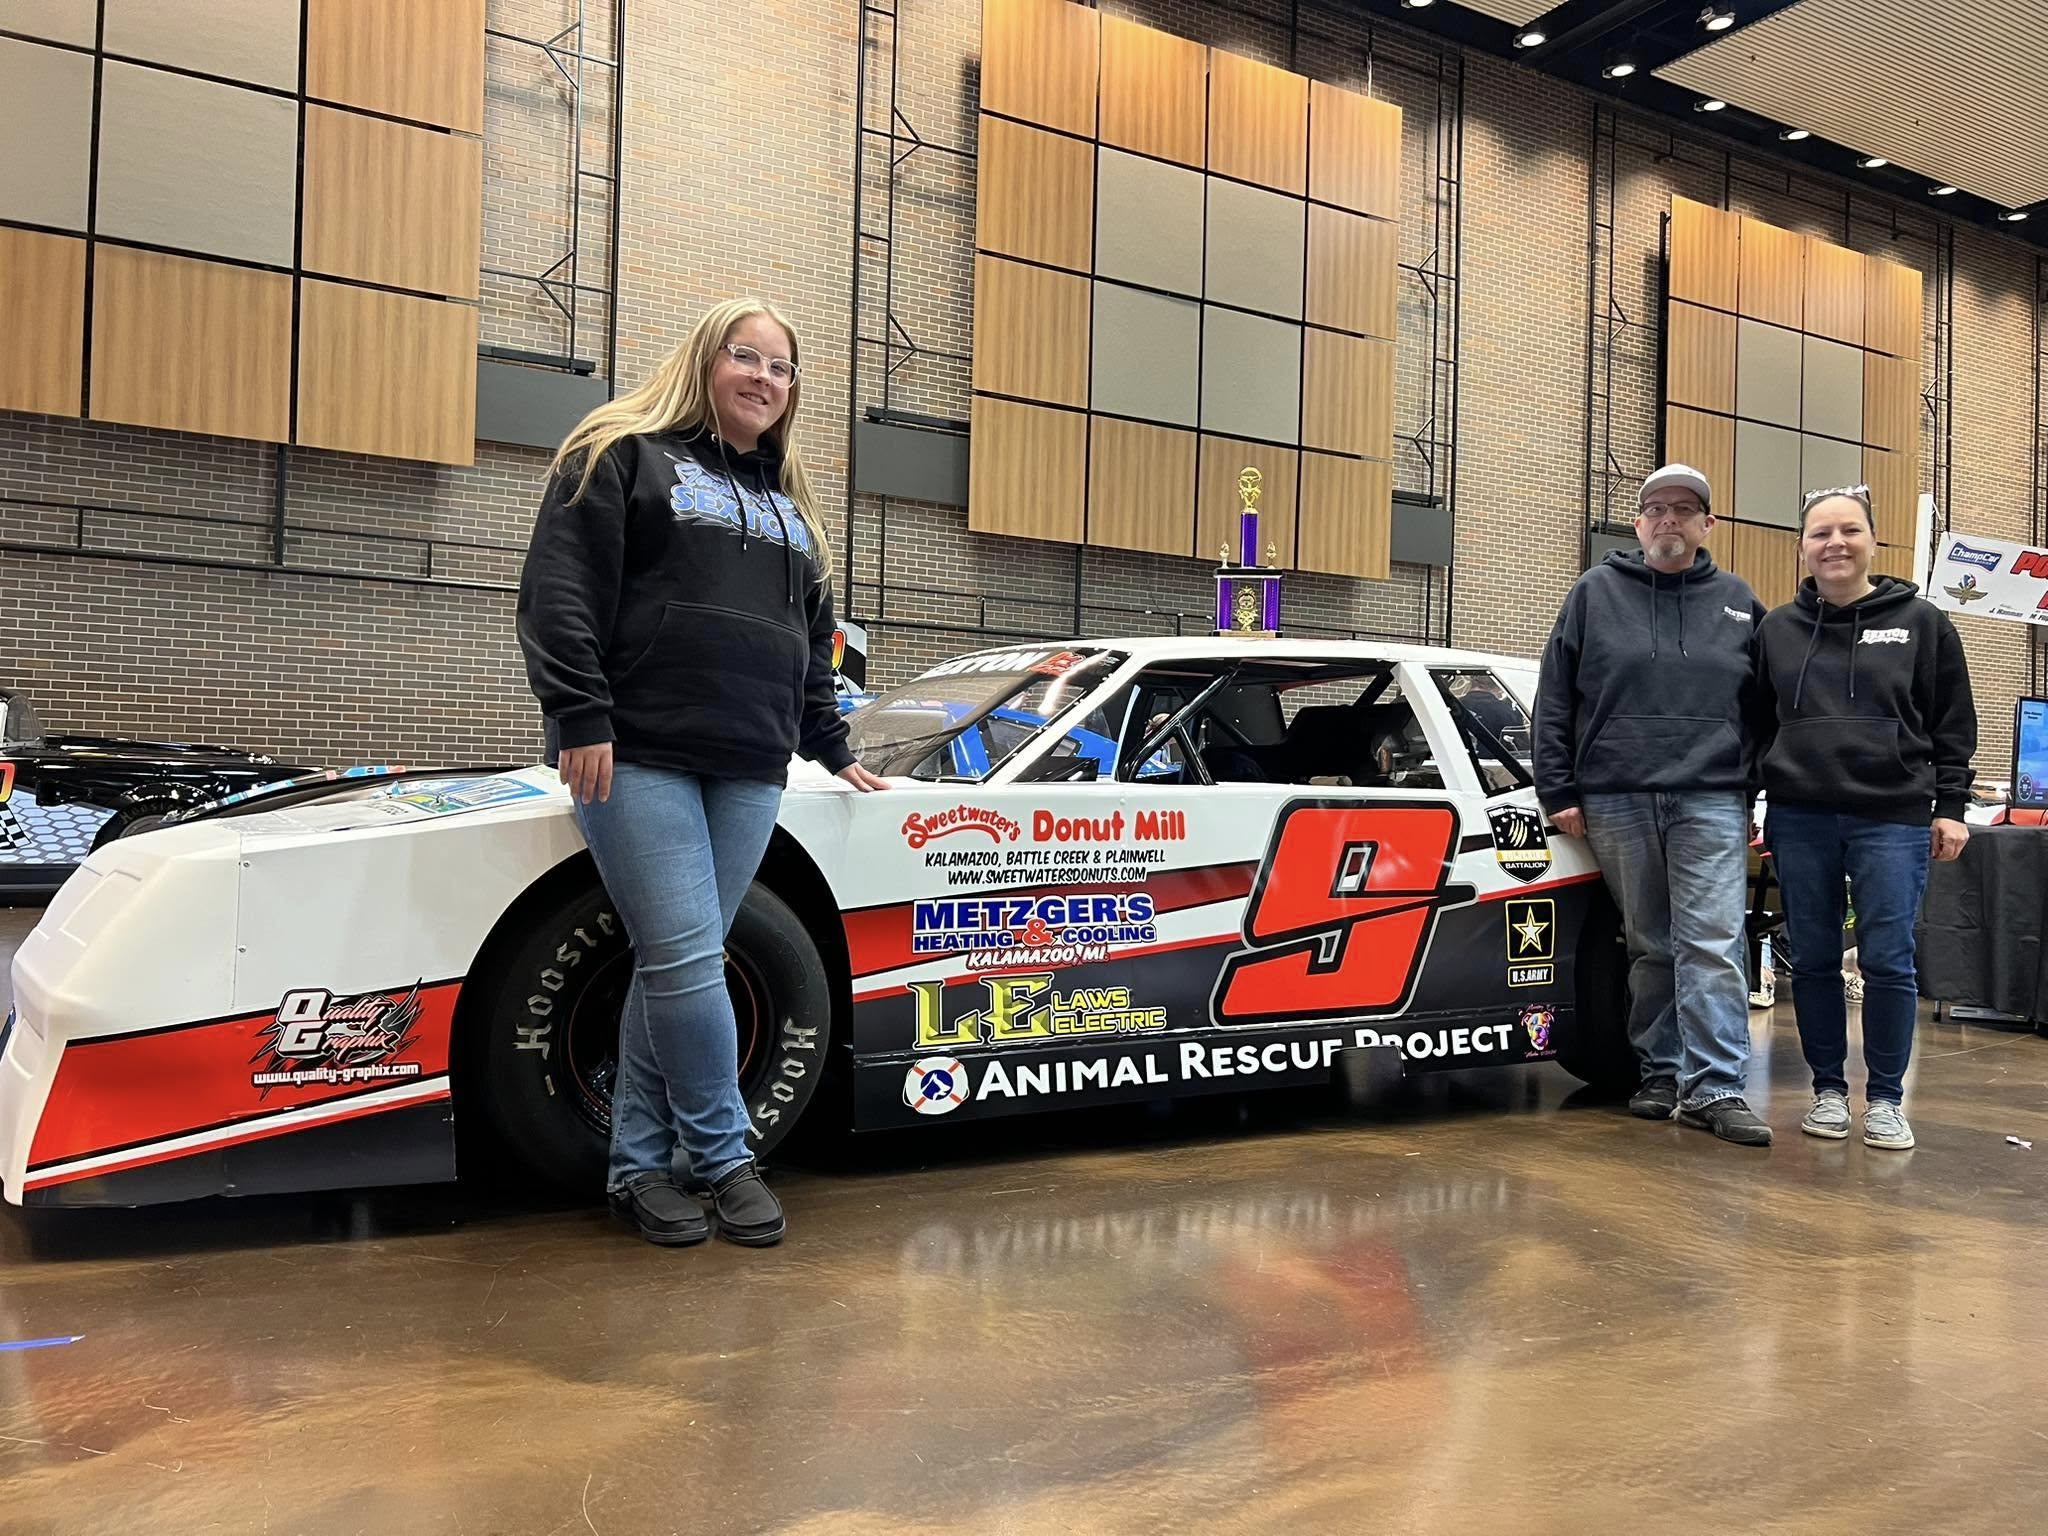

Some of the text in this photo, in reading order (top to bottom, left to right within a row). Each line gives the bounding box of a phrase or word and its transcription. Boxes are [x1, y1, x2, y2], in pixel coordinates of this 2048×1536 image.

[670, 484, 809, 553] SEXTON
[1951, 547, 2000, 563] ChampCar
[902, 804, 1186, 849] Sweetwater's Donut Mill
[925, 850, 1166, 867] KALAMAZOO, BATTLE CREEK & PLAINWELL
[948, 866, 1146, 885] WWW.SWEETWATERSDONUTS.COM
[915, 895, 1154, 931] METZGER'S
[1213, 798, 1470, 1028] 9
[914, 918, 1156, 952] HEATING & COOLING
[967, 947, 1109, 968] KALAMAZOO, MI.
[278, 990, 390, 1029] Quality
[1053, 988, 1129, 1012] LAWS
[1053, 1009, 1166, 1035] ELECTRIC
[278, 1020, 394, 1061] Graphix
[253, 1064, 419, 1085] www.quality-graphix.com
[975, 1054, 1169, 1101] ANIMAL
